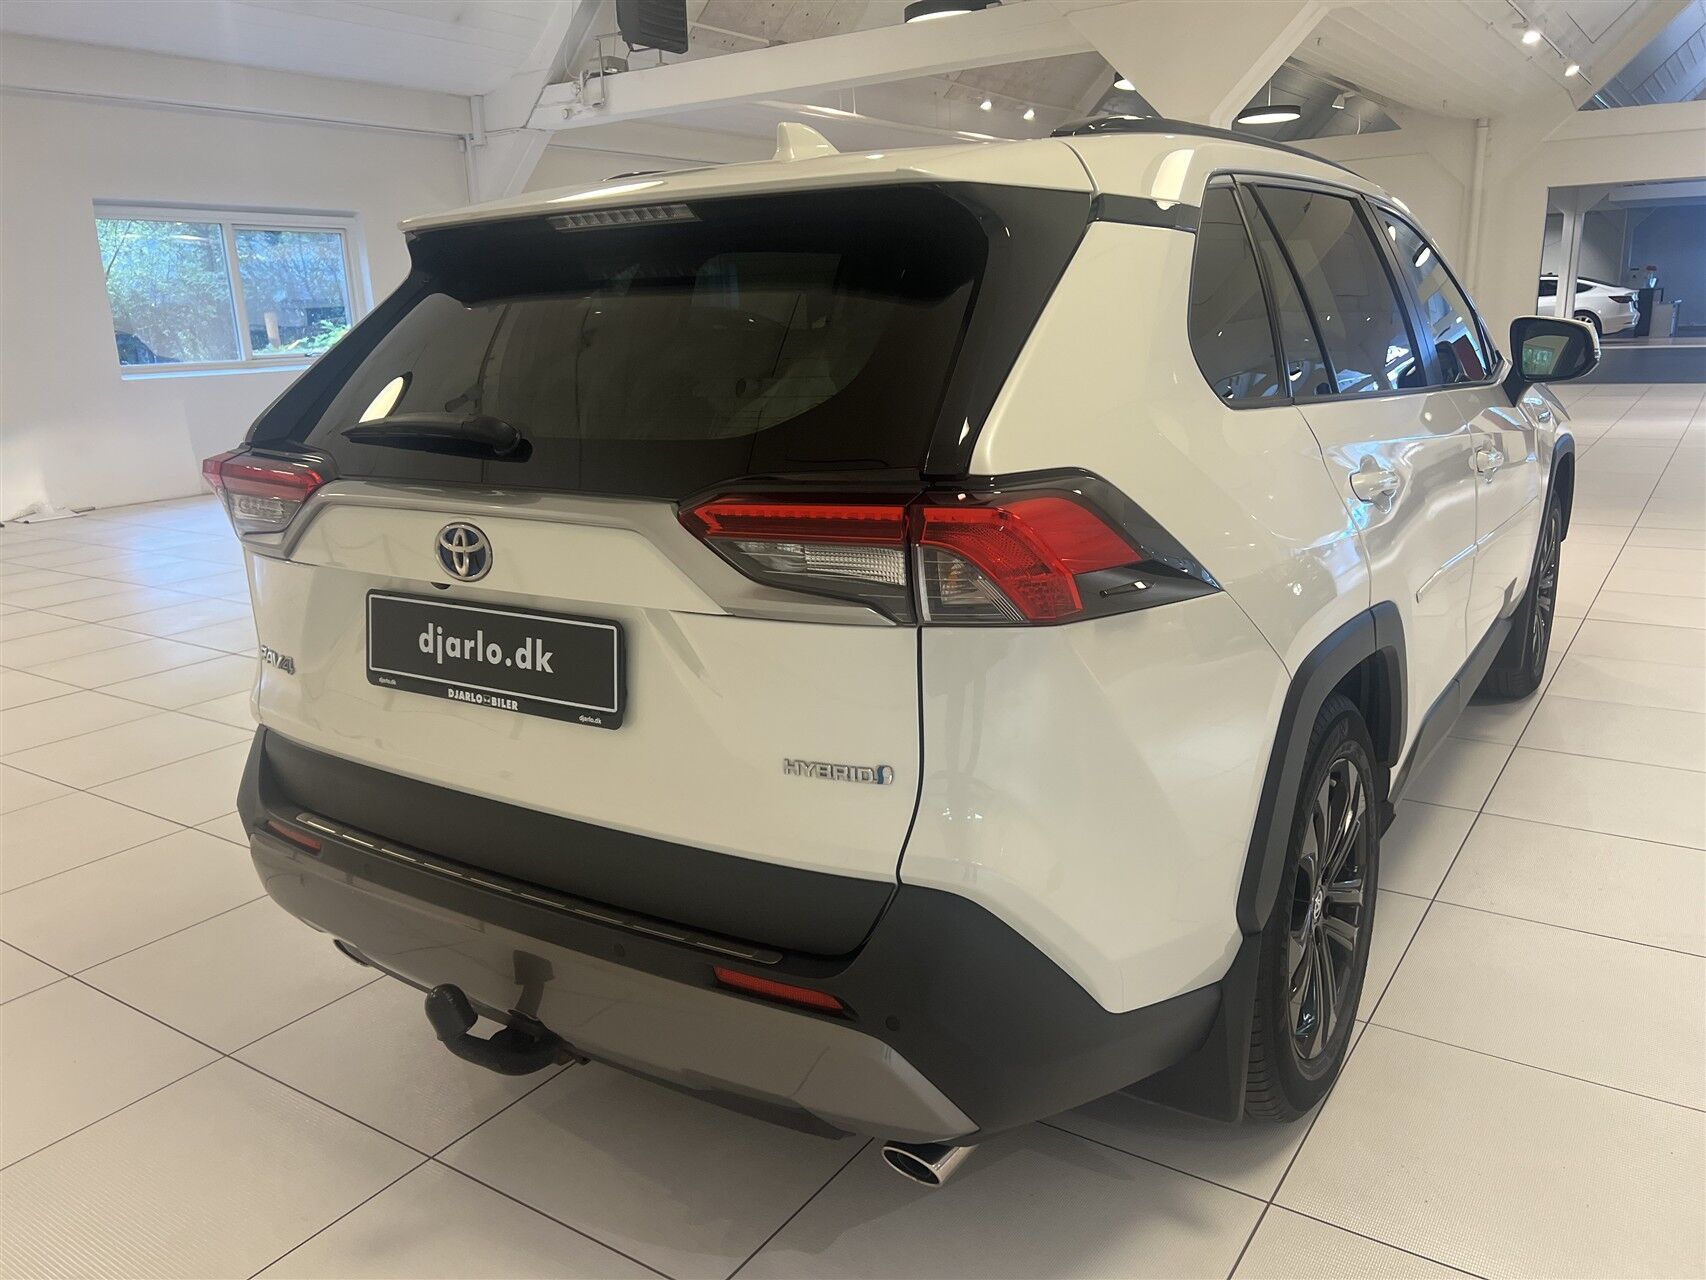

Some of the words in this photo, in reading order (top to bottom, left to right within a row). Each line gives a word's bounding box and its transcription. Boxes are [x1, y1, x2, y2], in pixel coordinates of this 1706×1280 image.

[418, 622, 554, 673] djarlo.dk
[447, 688, 483, 704] DJARLO
[491, 696, 518, 711] BILER
[783, 758, 875, 784] HYBRID
